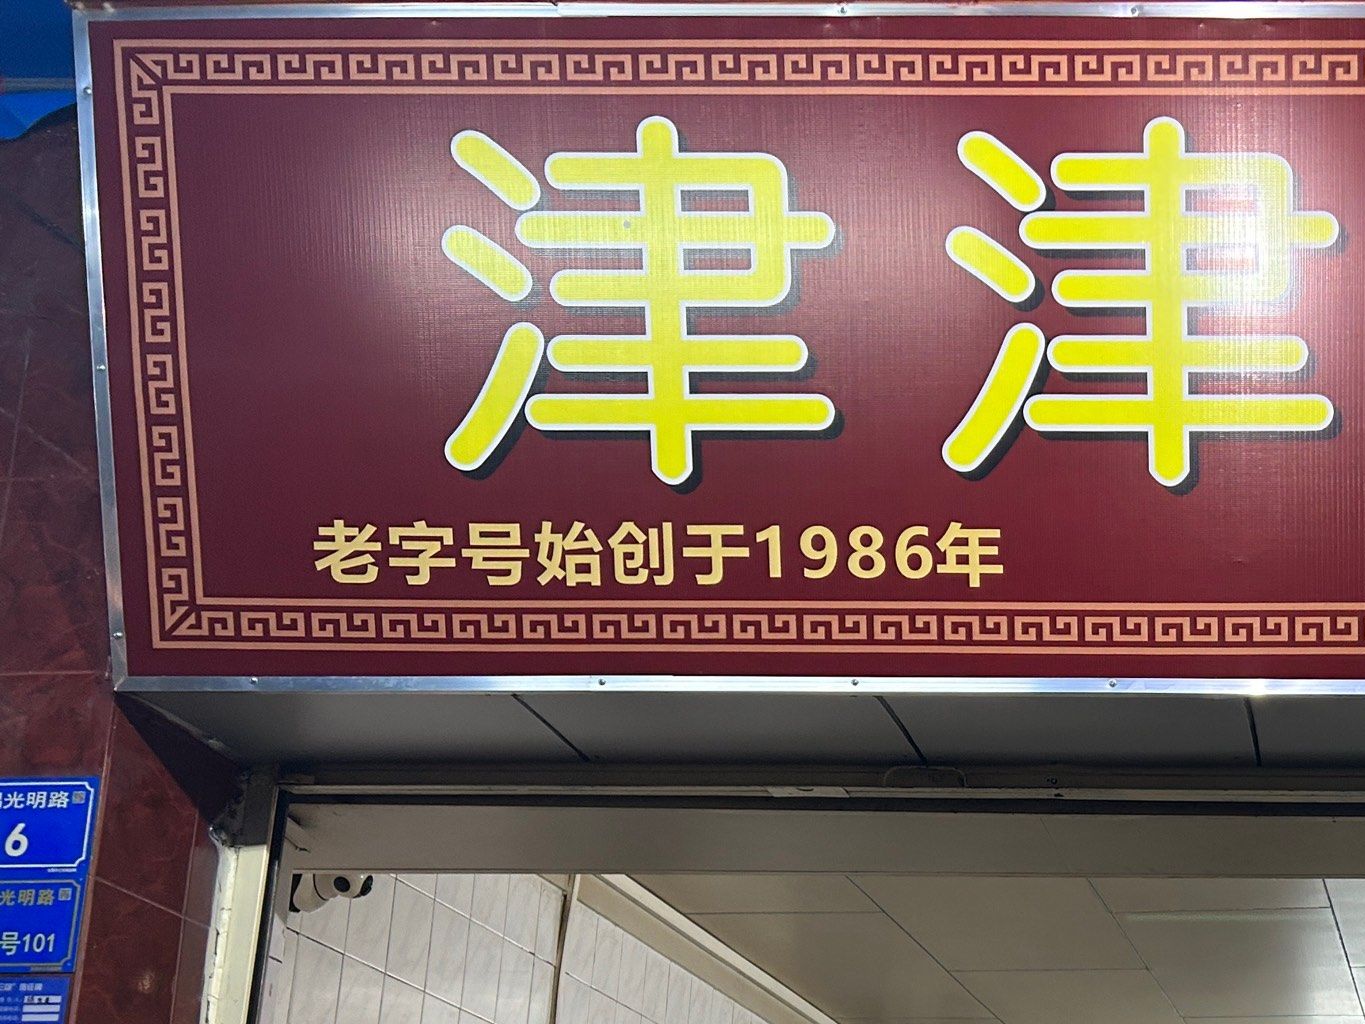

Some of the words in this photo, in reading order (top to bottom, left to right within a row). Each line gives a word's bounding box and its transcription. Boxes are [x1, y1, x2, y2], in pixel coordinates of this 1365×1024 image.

[313, 519, 1005, 588] 老字号始创于1986年
[0, 791, 69, 809] 光明路
